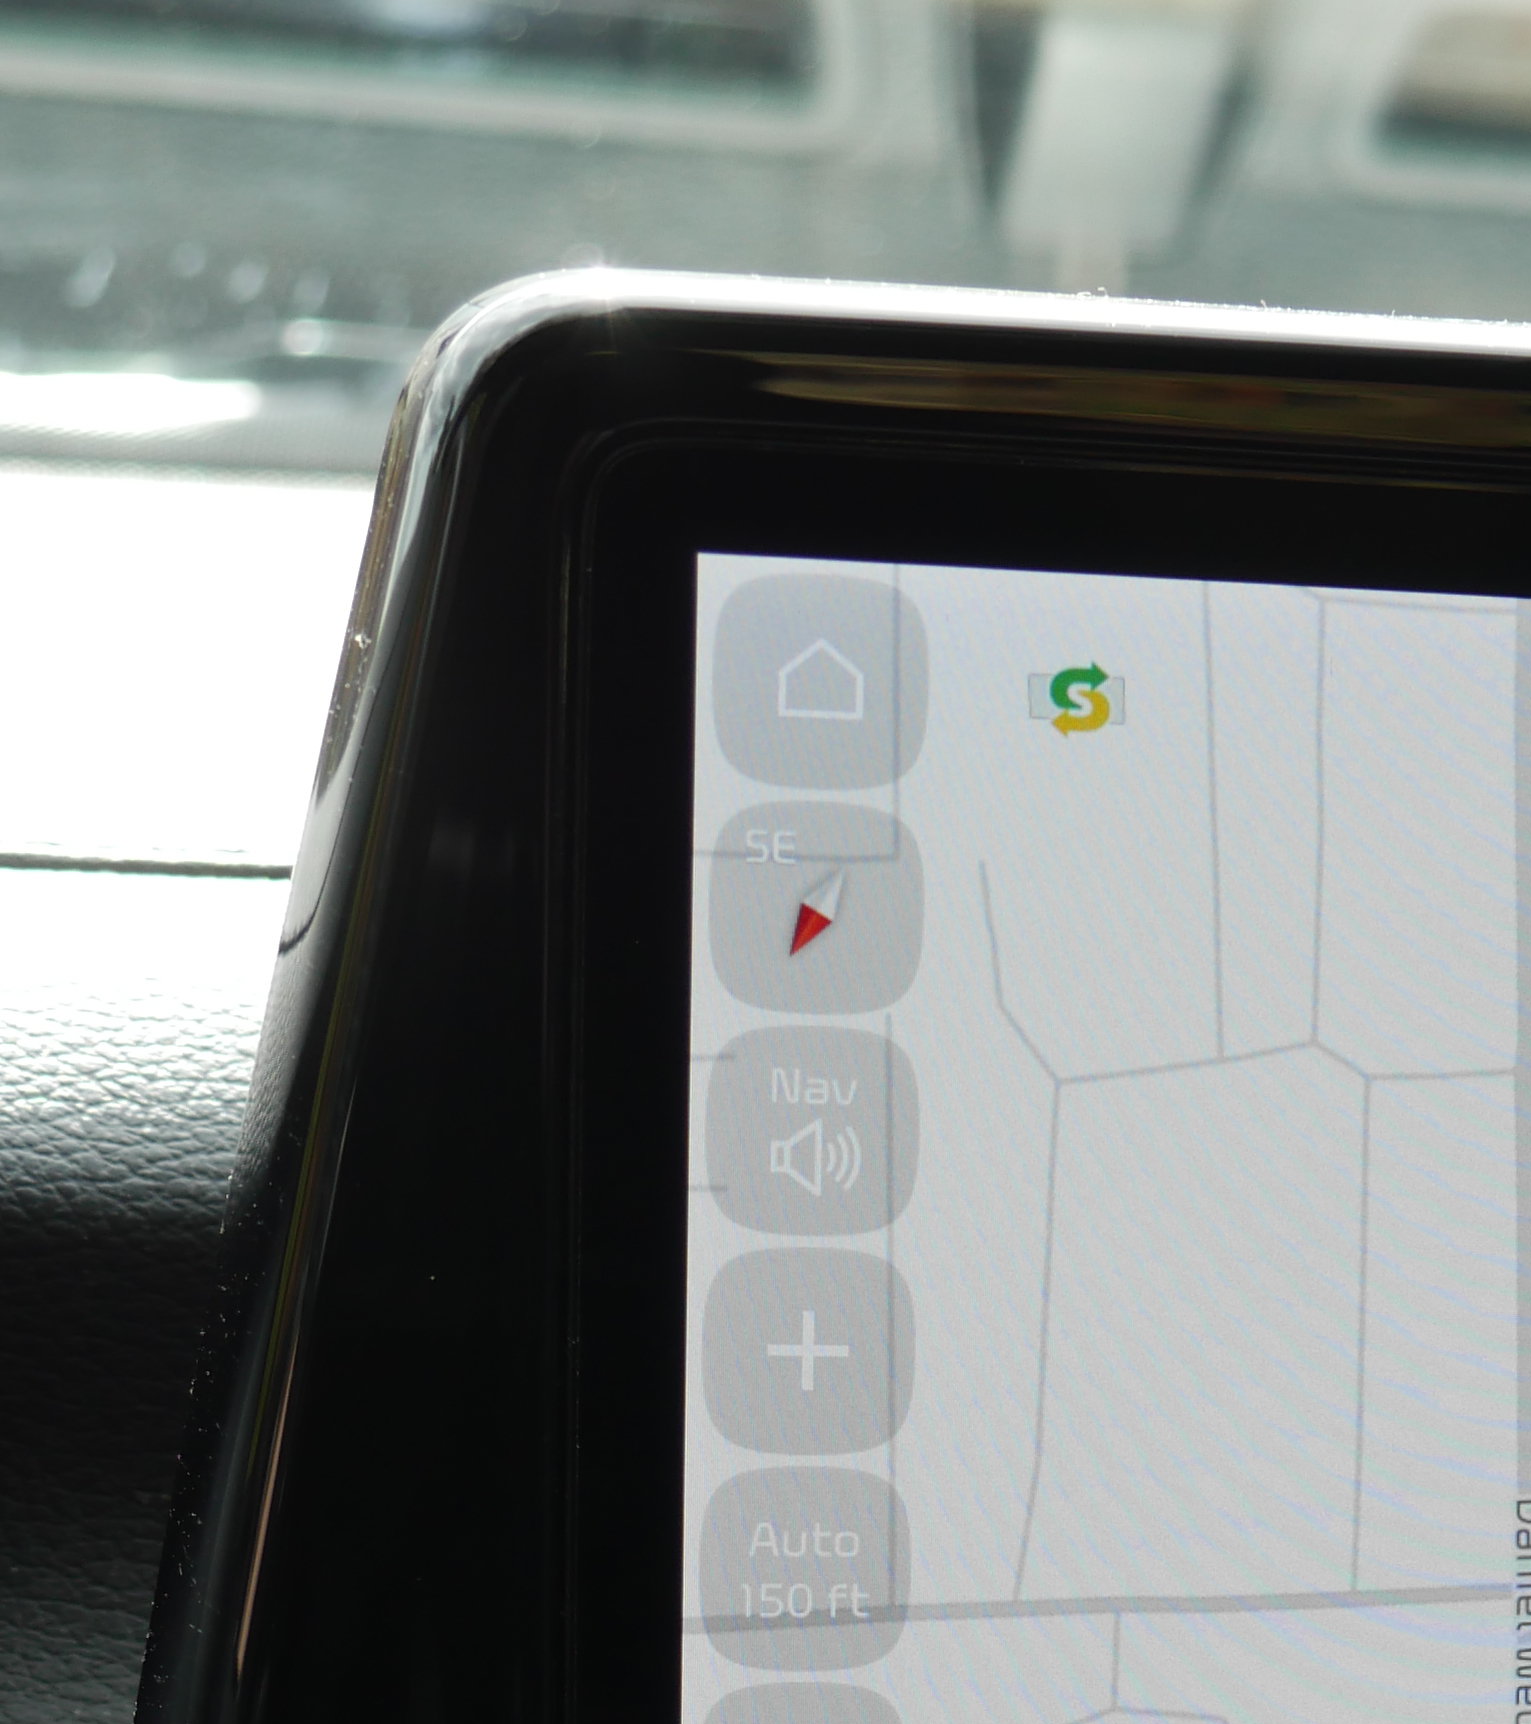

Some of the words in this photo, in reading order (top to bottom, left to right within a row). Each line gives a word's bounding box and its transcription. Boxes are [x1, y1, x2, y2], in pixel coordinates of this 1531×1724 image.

[746, 829, 797, 866] SE
[771, 1068, 858, 1106] Nav
[747, 1522, 861, 1558] Auto
[741, 1584, 815, 1620] 150
[828, 1582, 870, 1620] ft
